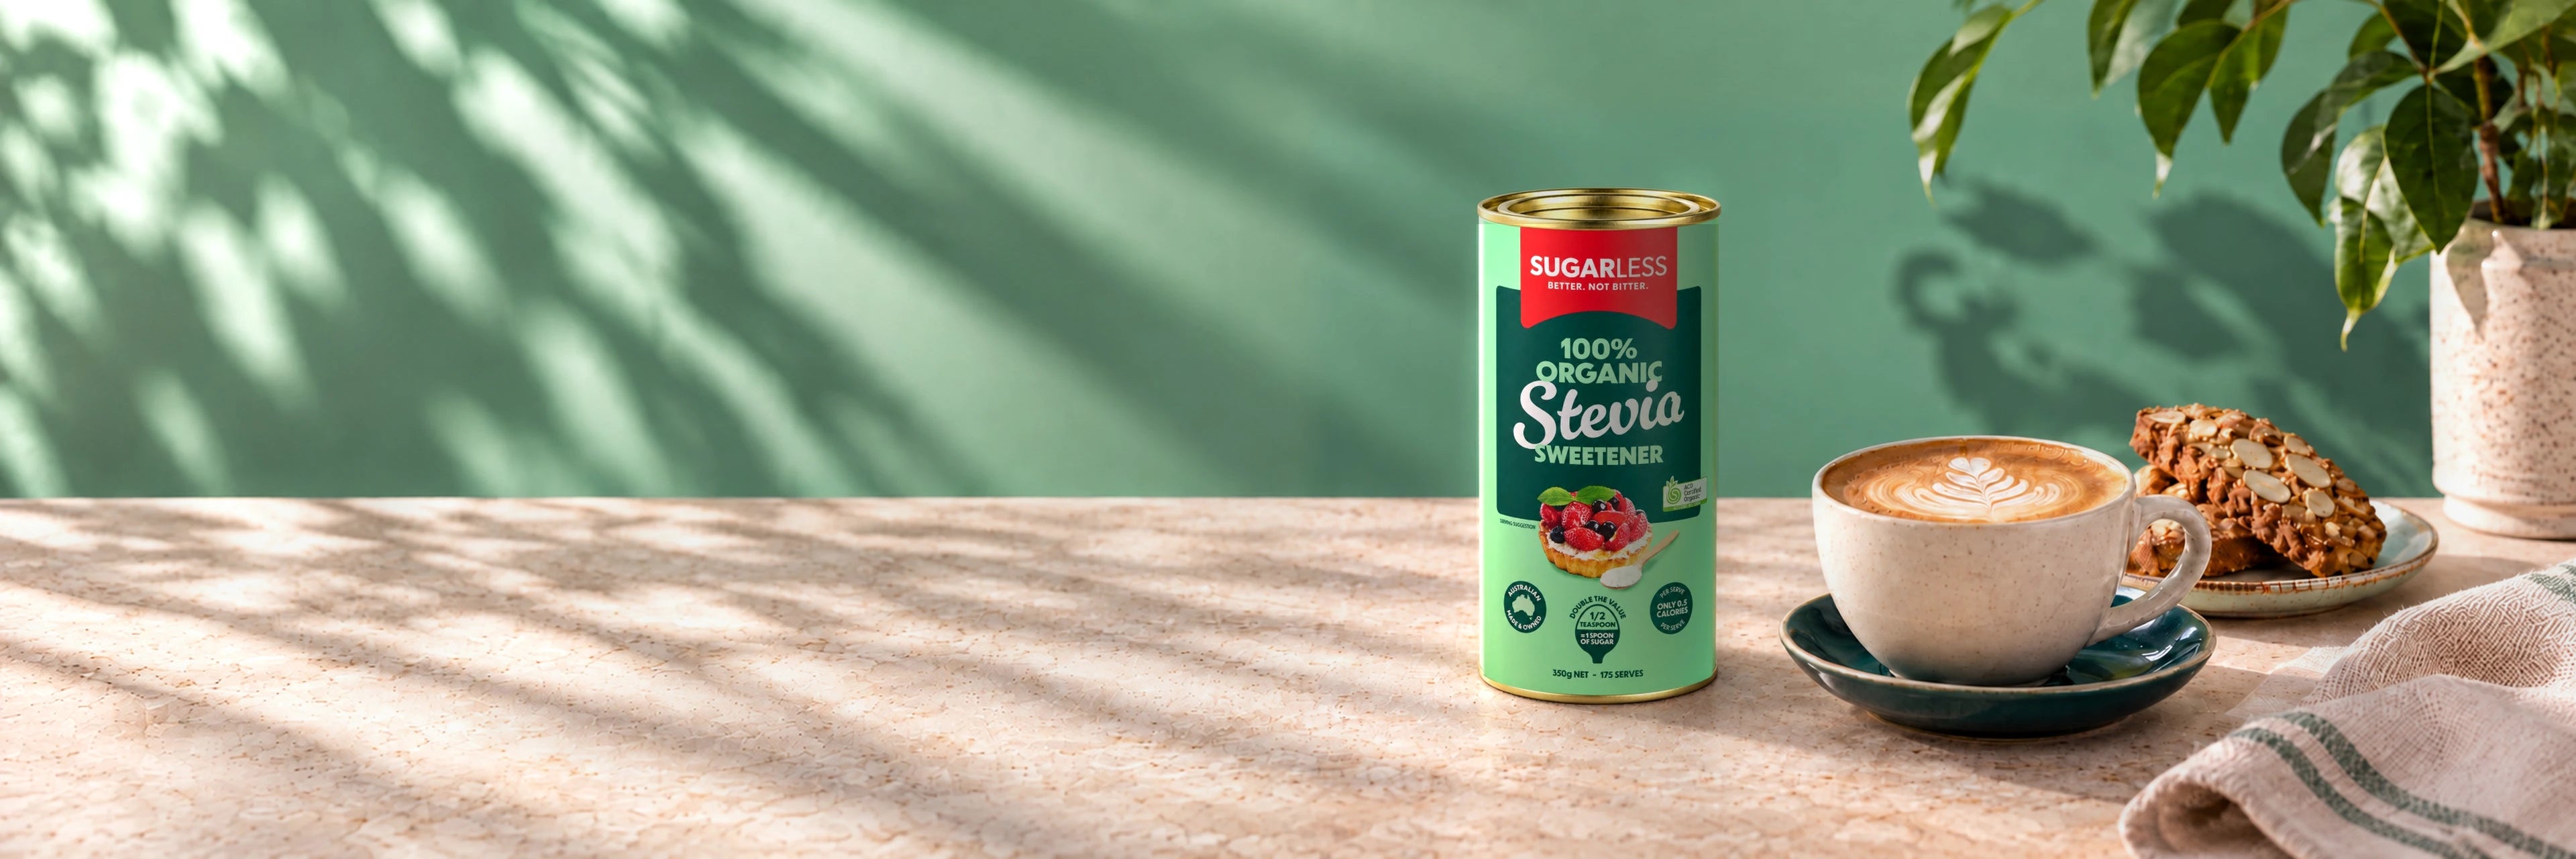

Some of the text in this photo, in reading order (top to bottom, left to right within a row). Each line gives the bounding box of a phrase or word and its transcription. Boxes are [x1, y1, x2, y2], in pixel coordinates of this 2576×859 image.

[1529, 256, 1668, 278] SUGARLESS
[1548, 281, 1649, 291] BETTER. NOT BITTER.
[1560, 338, 1638, 360] 100%
[1536, 360, 1662, 384] ORGANIC
[1513, 380, 1684, 449] Stevia
[1535, 445, 1664, 465] SWEETENER
[1508, 585, 1542, 601] AUSTRALIAN
[1660, 587, 1685, 598] PER SERVE
[1569, 596, 1593, 619] DOUBLE
[1609, 599, 1627, 619] VALUE
[1656, 606, 1688, 617] CALORIES
[1657, 599, 1687, 610] ONLY 0.5
[1507, 610, 1518, 626] MADE
[1523, 615, 1542, 630] OWNED
[1590, 611, 1606, 621] 1/2
[1660, 619, 1685, 630] PER SERVE
[1552, 669, 1572, 679] 350g
[1615, 669, 1644, 678] SERVES
